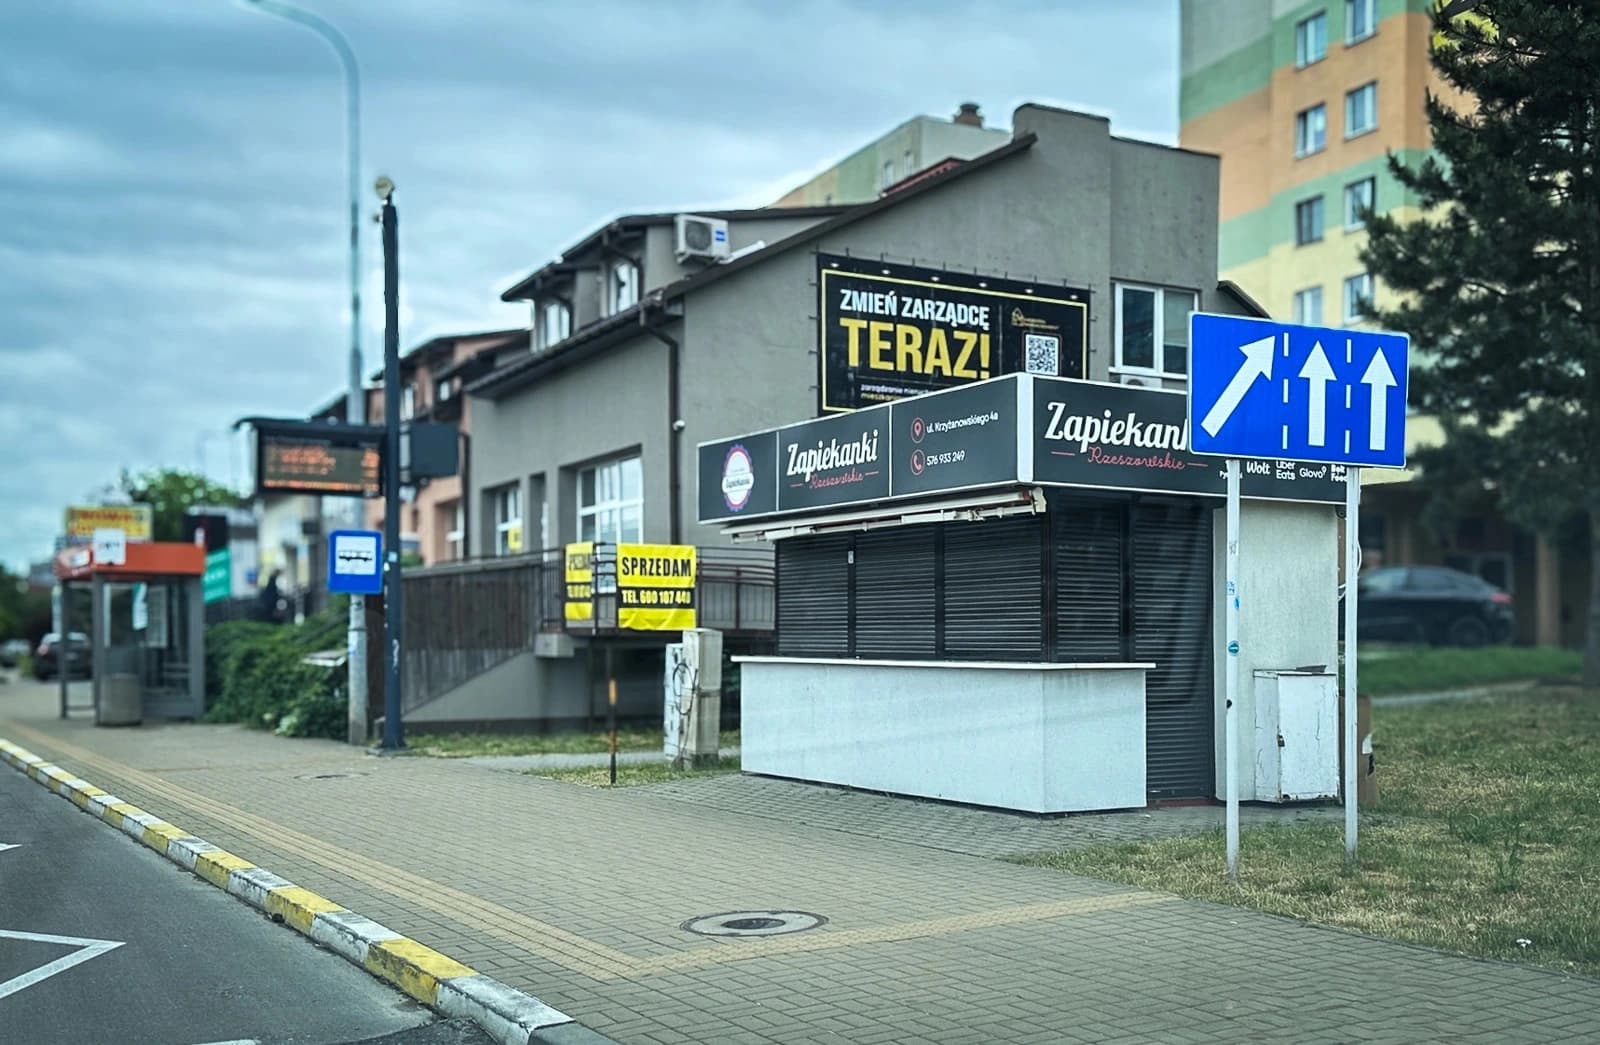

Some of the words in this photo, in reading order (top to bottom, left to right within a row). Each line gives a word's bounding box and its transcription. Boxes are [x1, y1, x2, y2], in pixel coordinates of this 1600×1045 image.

[840, 288, 897, 317] ZMIEŃ
[901, 296, 990, 330] ZARZĄDCĘ
[840, 317, 991, 379] TERAZ!
[786, 429, 879, 483] Zapiekanki
[939, 452, 952, 464] 933
[952, 450, 965, 463] 249
[1087, 446, 1186, 471] Rzeszowskie
[1246, 461, 1271, 475] Wolt
[1276, 460, 1296, 470] Uber
[1300, 467, 1324, 480] Glovo
[1276, 470, 1296, 481] Eats
[622, 556, 692, 577] SPRZEDAM
